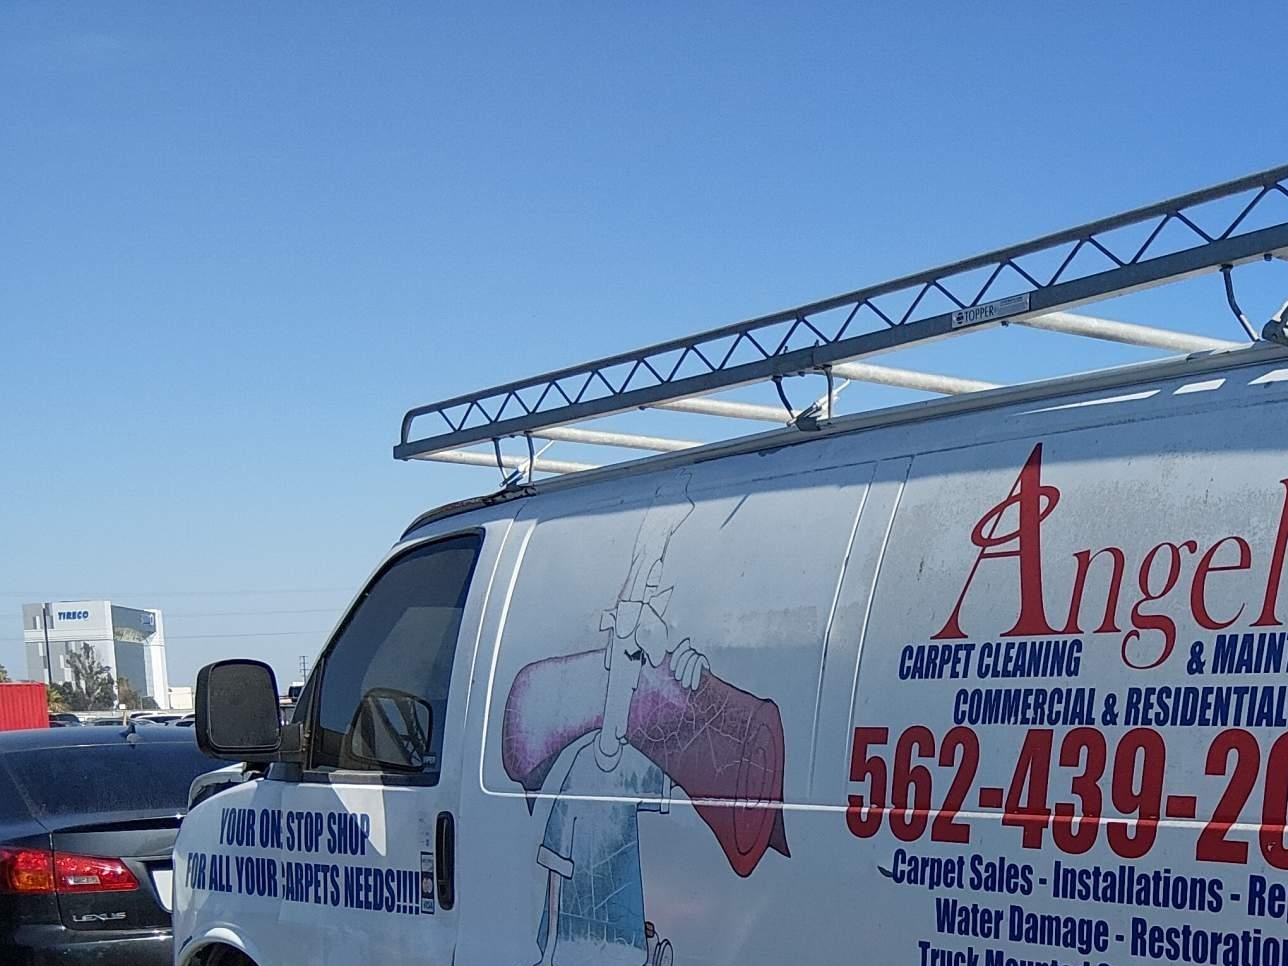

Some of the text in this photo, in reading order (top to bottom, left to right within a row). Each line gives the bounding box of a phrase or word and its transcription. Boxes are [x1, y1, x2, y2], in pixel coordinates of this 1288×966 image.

[964, 305, 994, 322] TOPPER
[58, 611, 89, 620] TIRECO
[899, 638, 1083, 681] CARPET CLEANING
[1187, 640, 1206, 676] &
[953, 685, 1287, 727] COMMERCIAL & RESIDENTIAL
[219, 807, 256, 847] YOUR
[286, 811, 324, 852] STOP
[327, 811, 370, 856] SHOP
[185, 852, 206, 890] FOR
[209, 854, 233, 893] ALL
[235, 856, 278, 898] YOUR
[344, 864, 420, 915] NEEDS!!!!
[891, 848, 964, 890] Carpet
[969, 856, 1033, 896] Sales
[1053, 861, 1223, 913] Installations
[72, 911, 127, 922] LEXUS
[935, 897, 1004, 941] Water
[1008, 904, 1109, 955] Damage
